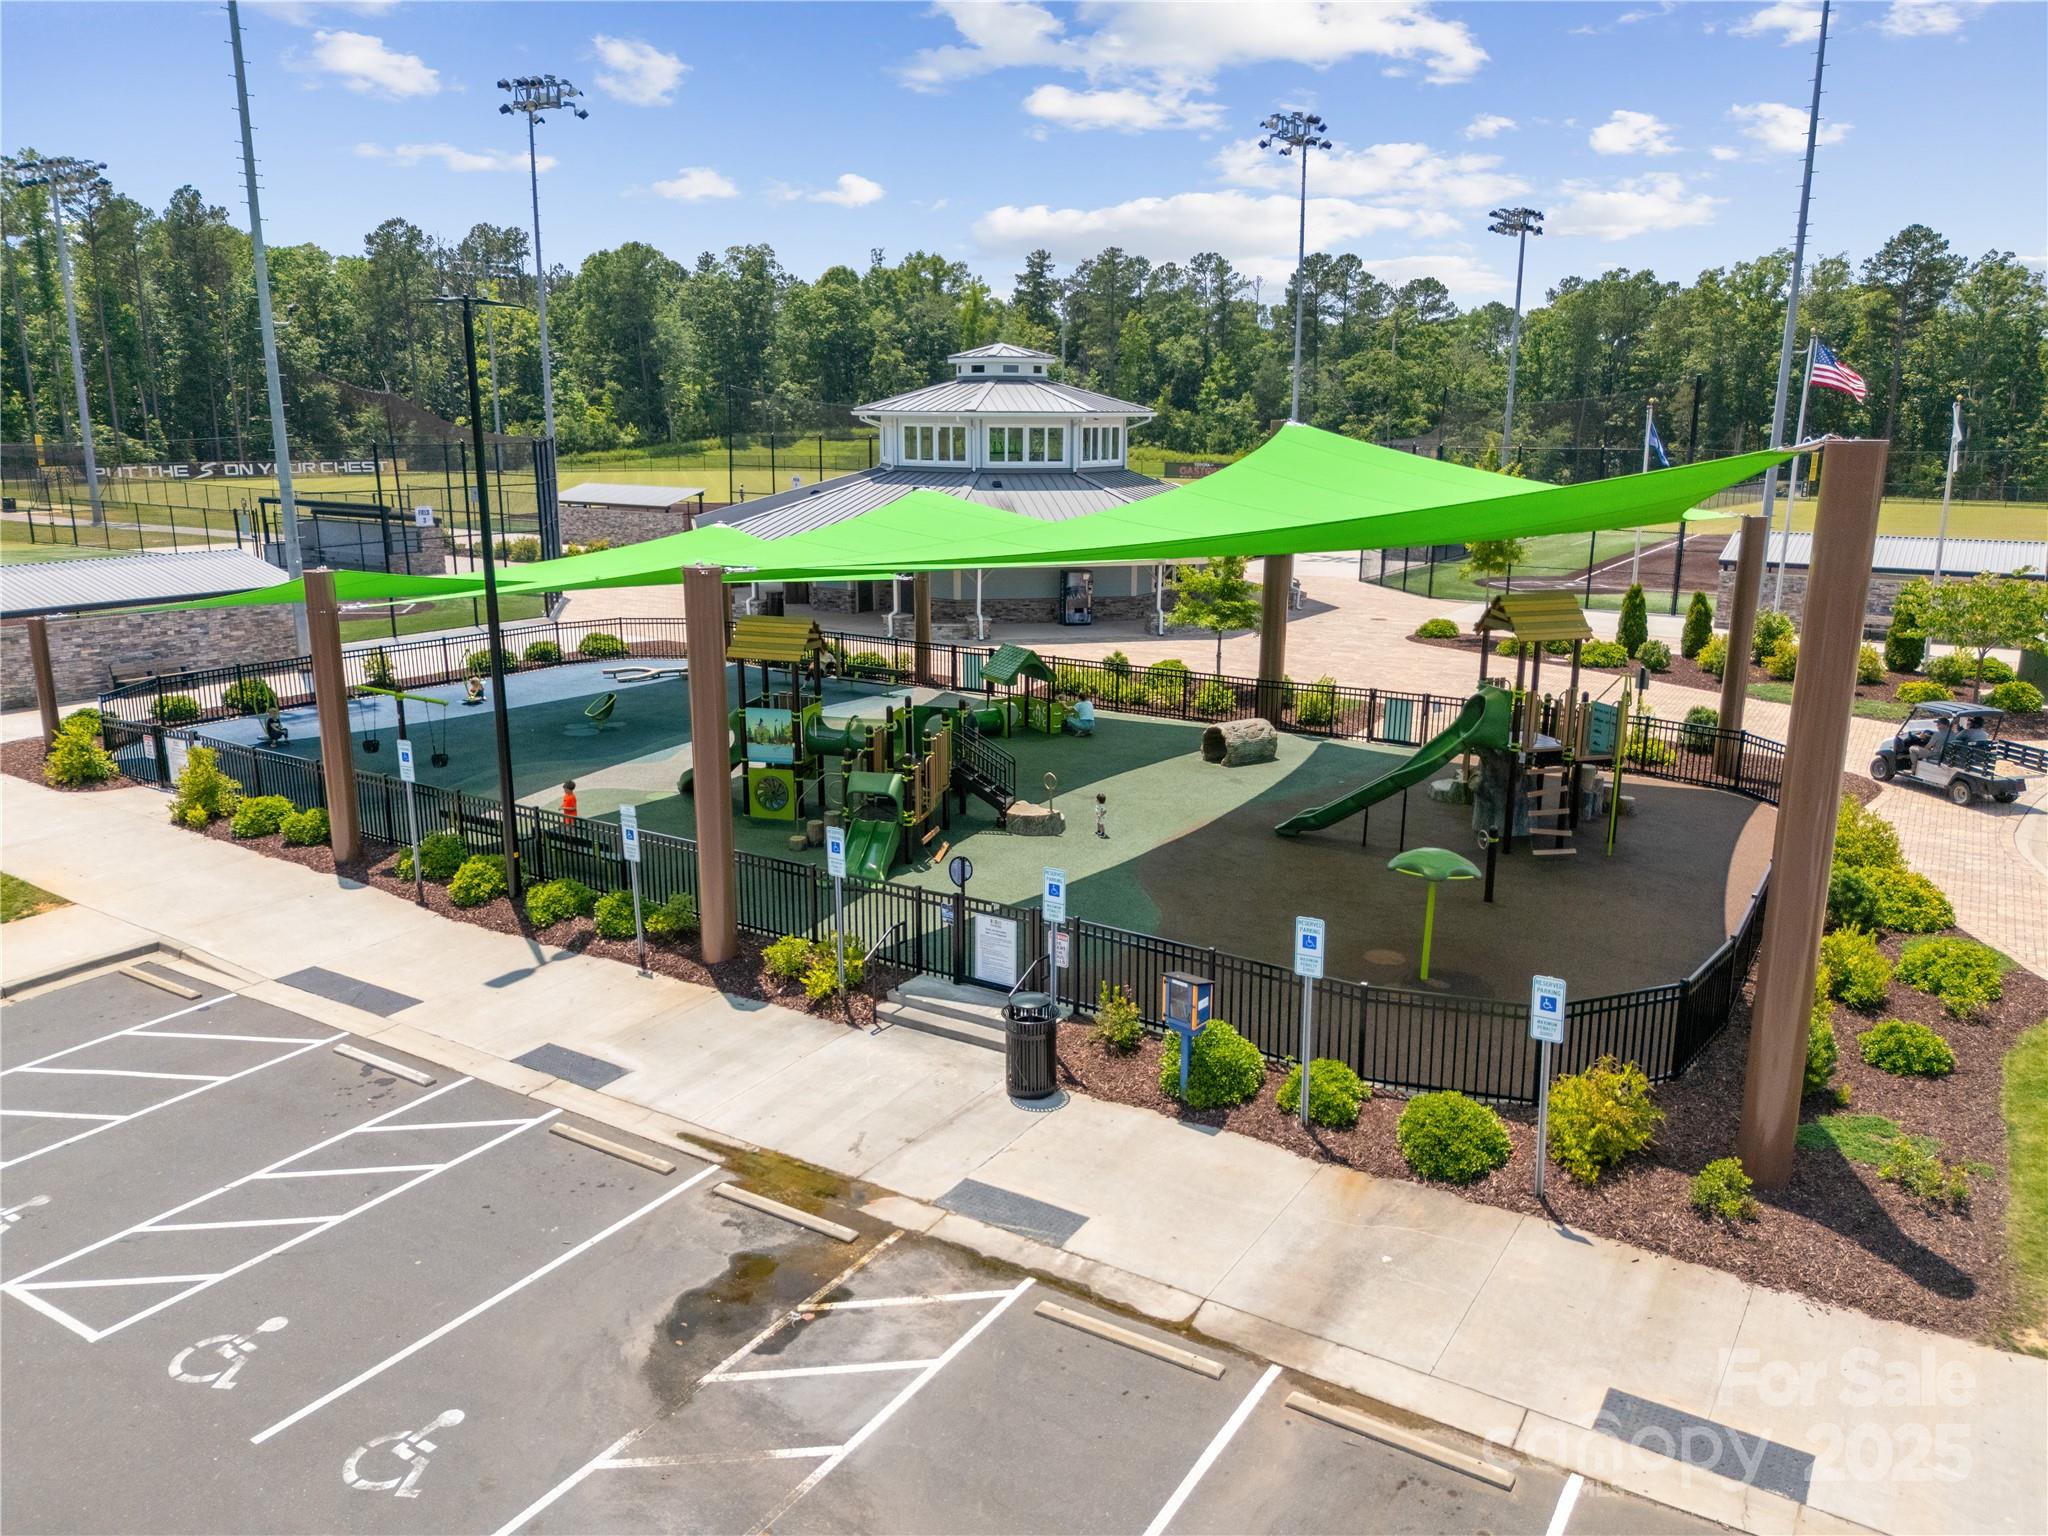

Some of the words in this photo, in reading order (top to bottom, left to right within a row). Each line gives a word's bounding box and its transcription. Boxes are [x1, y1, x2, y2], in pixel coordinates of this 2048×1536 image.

[142, 464, 190, 478] THE
[224, 463, 254, 476] ON
[320, 461, 388, 473] CHEST
[1298, 920, 1323, 928] RESERVED
[1299, 927, 1321, 935] PARKING
[1535, 980, 1564, 990] RESERVED
[1536, 987, 1562, 997] PARKING
